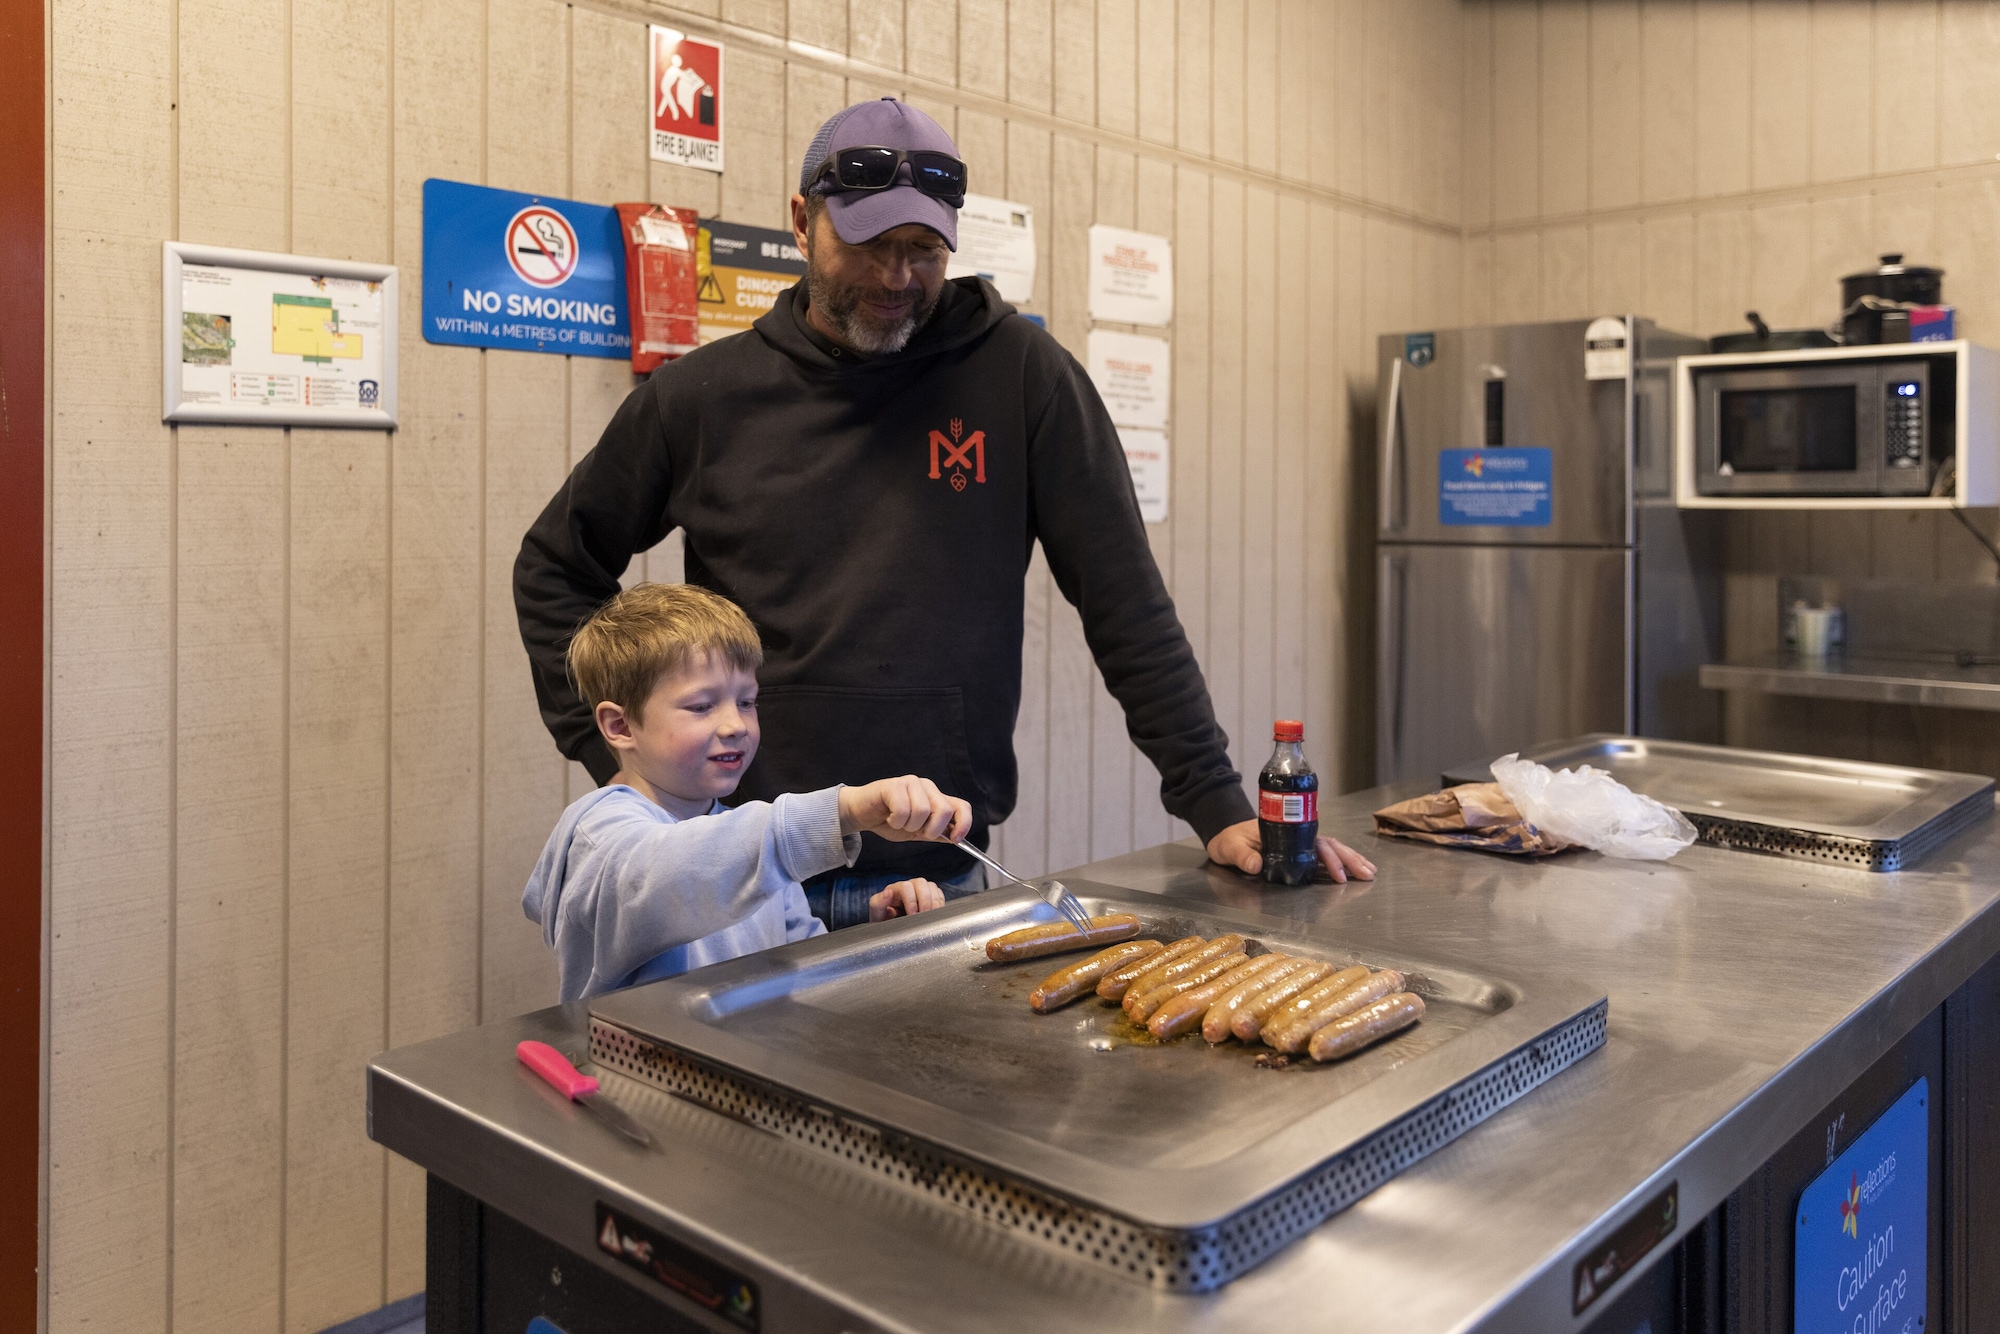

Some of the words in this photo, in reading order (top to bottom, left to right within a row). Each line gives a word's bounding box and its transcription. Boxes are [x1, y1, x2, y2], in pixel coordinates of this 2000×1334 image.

[656, 133, 675, 155] FIRE
[678, 138, 719, 162] BLANKET
[761, 242, 779, 258] BE
[780, 244, 808, 262] DIN
[463, 288, 501, 313] NO
[506, 293, 616, 326] SMOKING
[435, 316, 489, 335] WITHIN
[491, 326, 500, 338] 4
[502, 323, 556, 341] METRES
[558, 329, 577, 343] OF
[579, 331, 631, 348] BUILDIN
[1860, 1151, 1896, 1205] reflections
[1837, 1224, 1894, 1312] Caution
